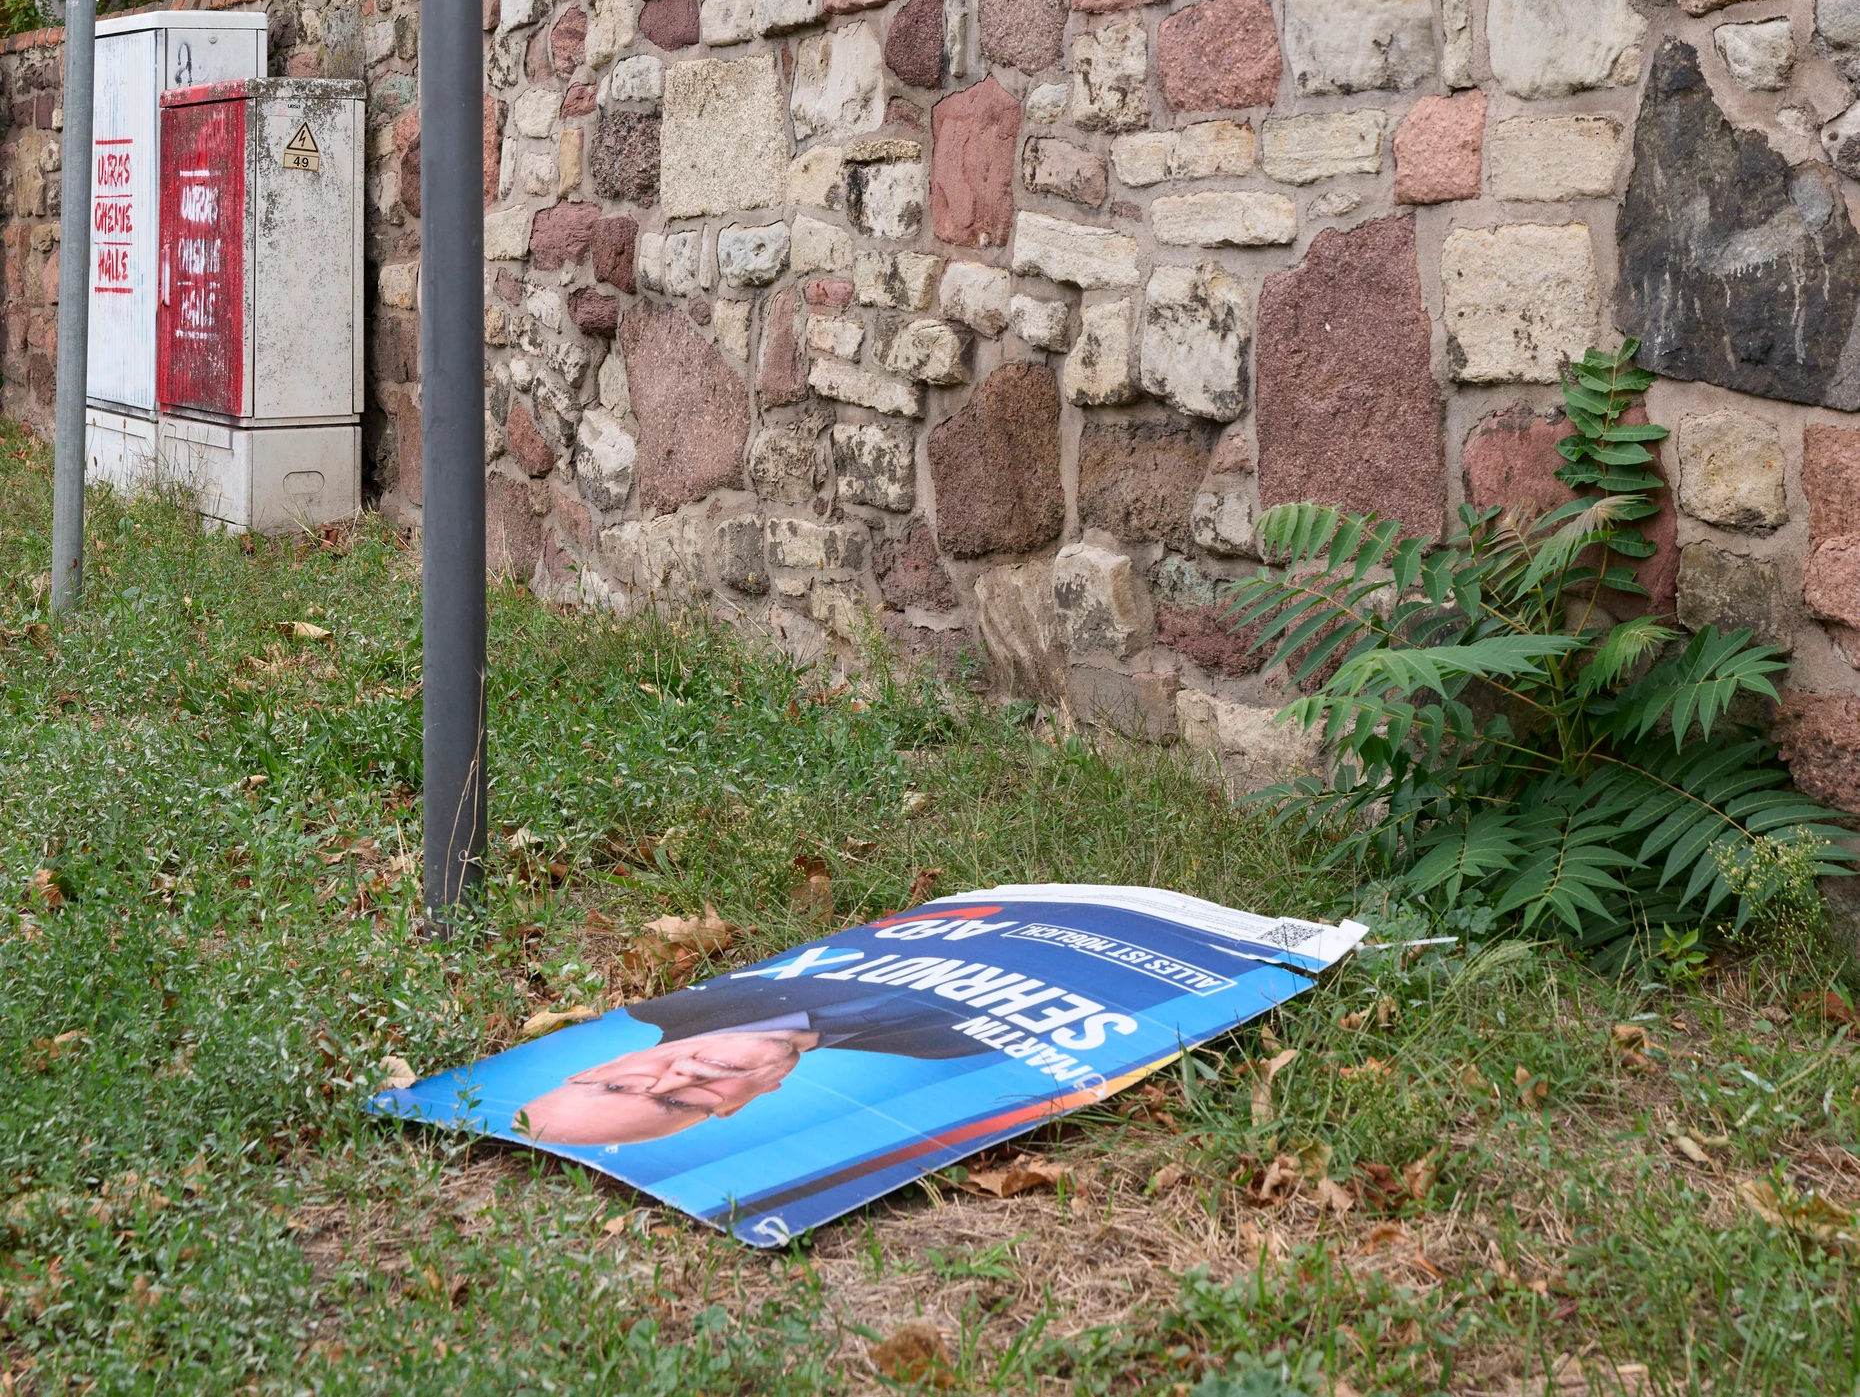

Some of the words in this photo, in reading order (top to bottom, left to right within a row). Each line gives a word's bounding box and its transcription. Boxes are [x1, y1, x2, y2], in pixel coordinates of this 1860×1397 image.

[293, 156, 309, 168] 49
[97, 249, 129, 283] HALLE
[875, 919, 1019, 941] AfD
[1020, 925, 1113, 951] MÖGLICH.
[1105, 947, 1153, 964] IST
[1143, 958, 1224, 989] ALLES
[813, 954, 1138, 1050] SEHRNDT
[952, 1015, 1093, 1082] MARTIN
